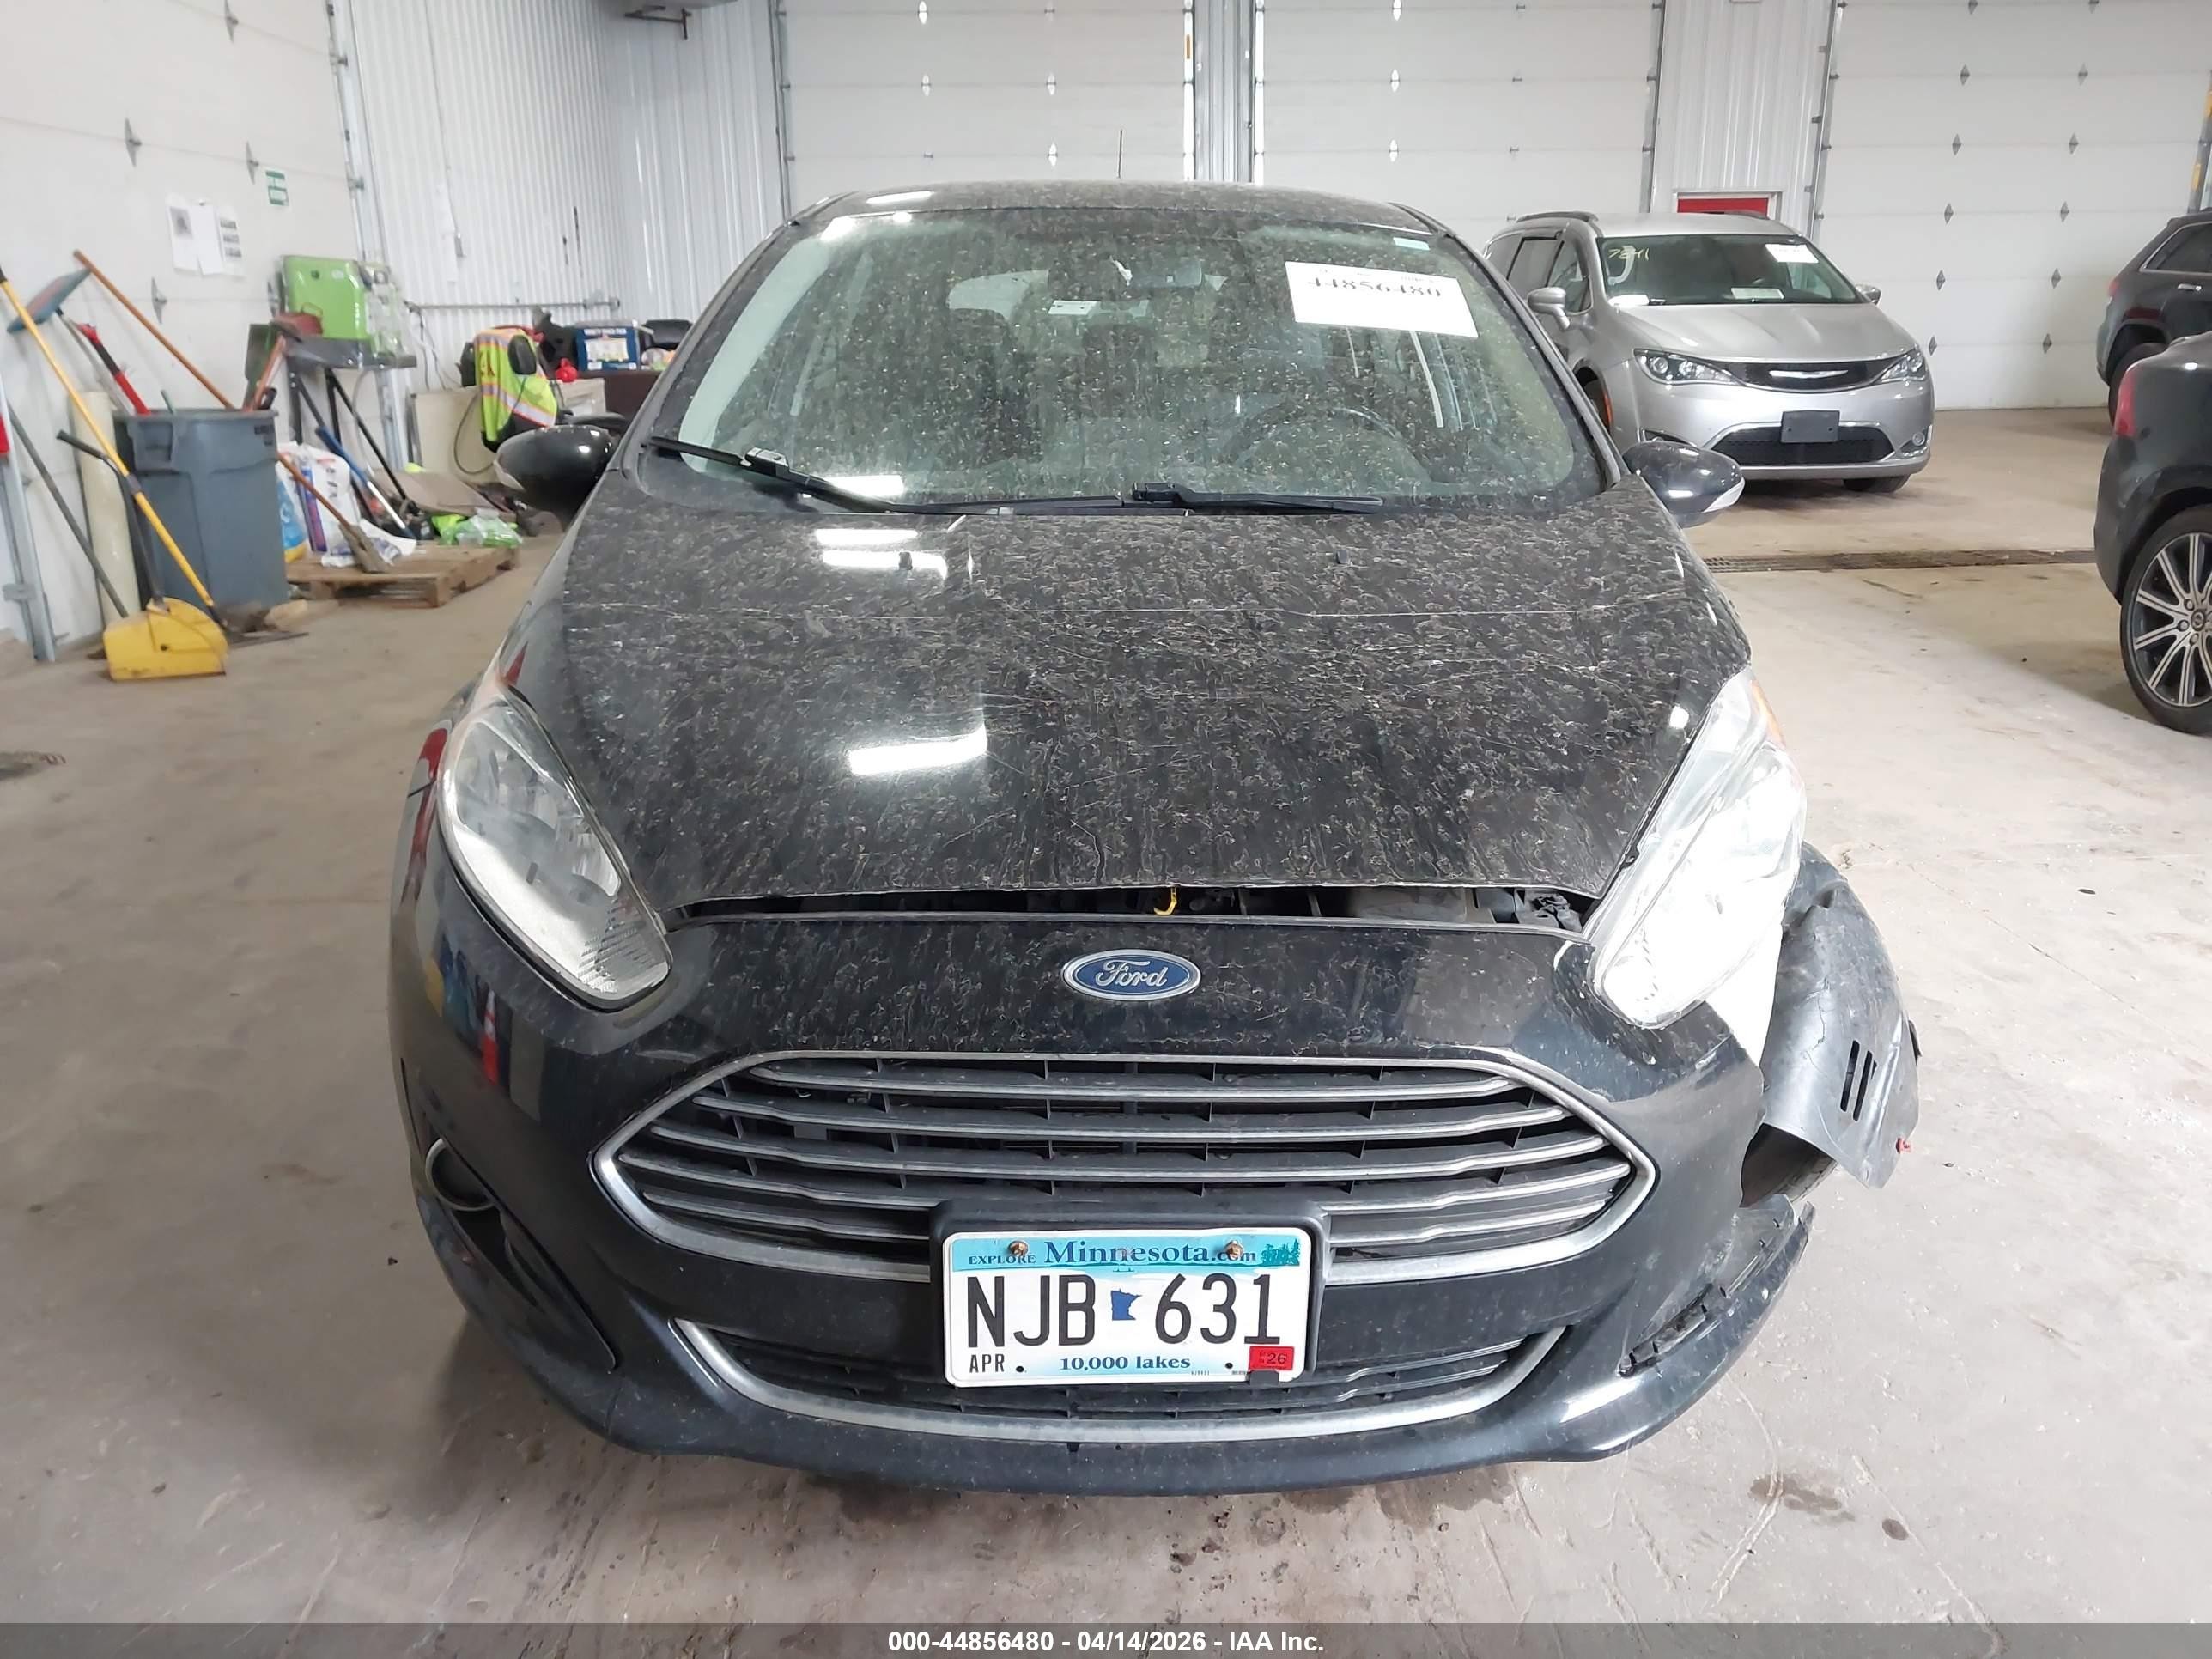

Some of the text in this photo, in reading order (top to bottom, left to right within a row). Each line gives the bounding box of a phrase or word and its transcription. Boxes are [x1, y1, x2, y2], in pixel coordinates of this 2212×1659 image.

[1095, 959, 1168, 987] Ford
[969, 1255, 1036, 1265] EXPLORE
[967, 1273, 1280, 1348] NJB 631
[969, 1353, 1005, 1373] APR
[1060, 1355, 1192, 1372] 10,000 lakes
